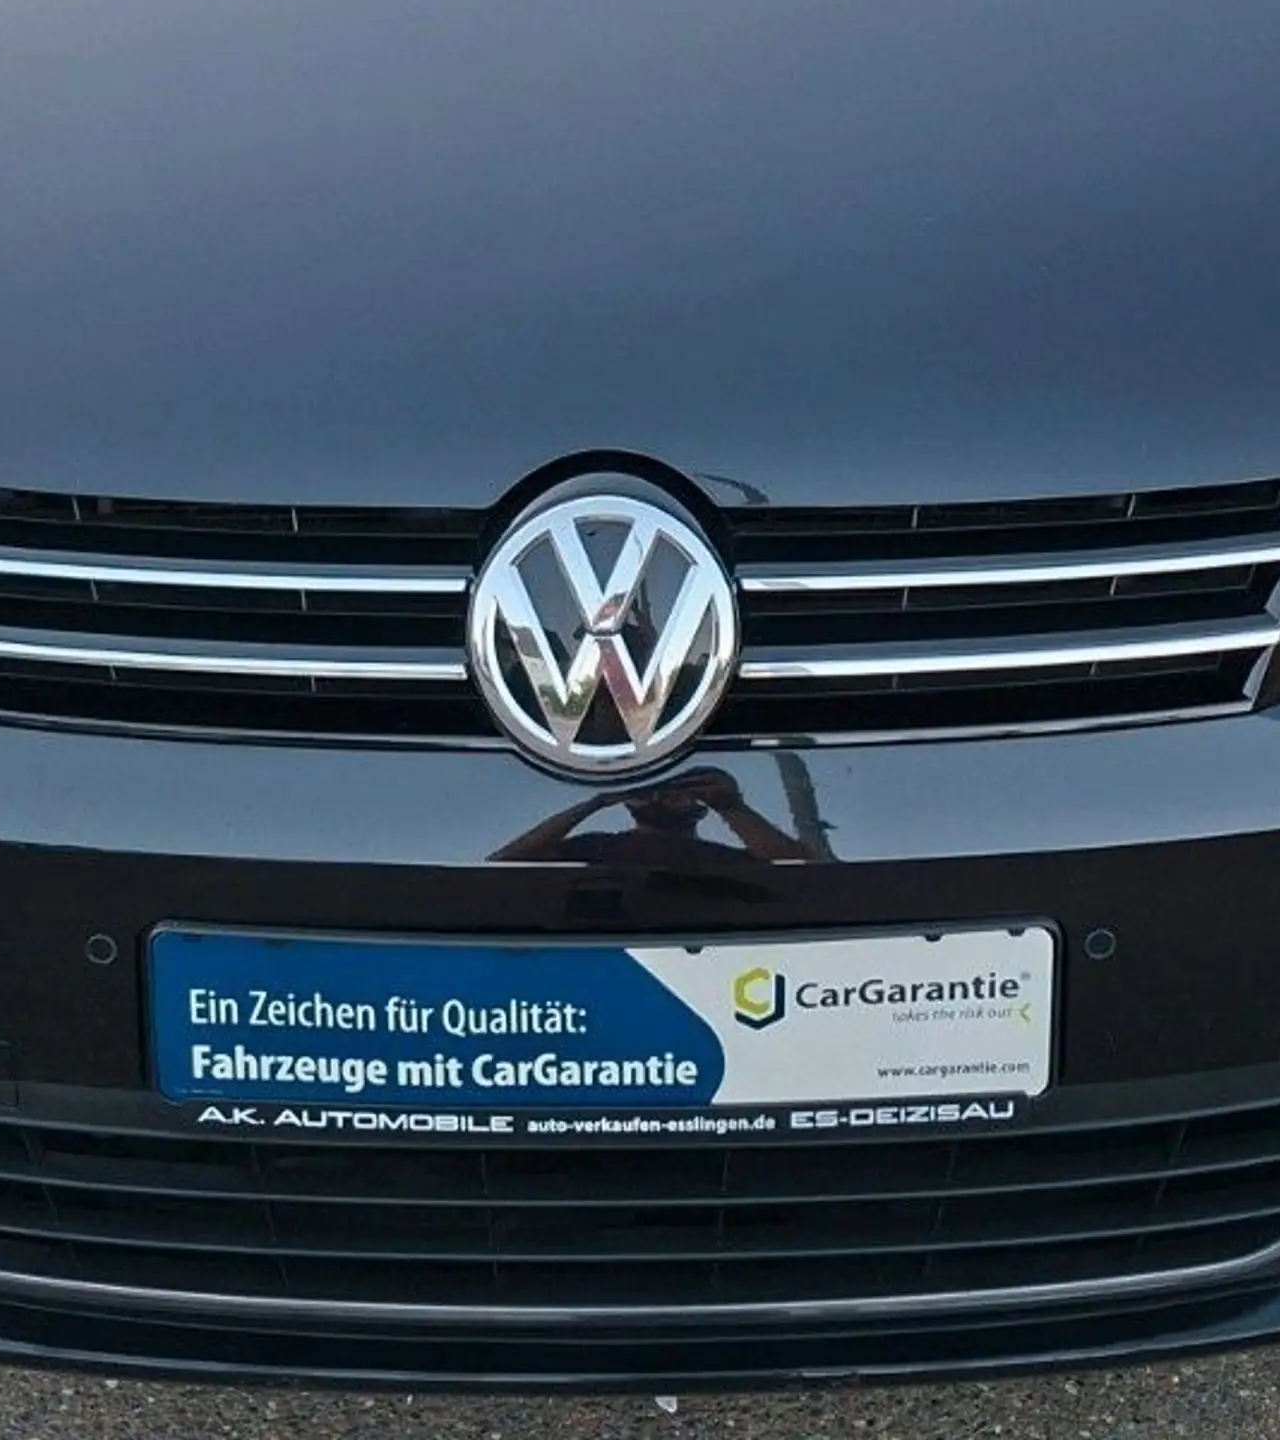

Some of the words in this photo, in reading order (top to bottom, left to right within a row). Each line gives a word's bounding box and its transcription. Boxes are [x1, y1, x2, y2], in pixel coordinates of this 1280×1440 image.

[795, 971, 1020, 1009] CarGarantie
[189, 988, 238, 1024] Ein
[248, 990, 376, 1031] Zeichen
[385, 996, 434, 1034] für
[442, 998, 587, 1037] Qualität:
[932, 1007, 957, 1021] the
[191, 1044, 388, 1093] Fahrzeuge
[397, 1053, 463, 1087] mit
[471, 1052, 698, 1087] CarGarantie
[876, 1060, 1031, 1079] www.cargarantie.com
[197, 1106, 265, 1125] A.K.
[273, 1108, 514, 1133] AUTOMOBILE
[527, 1113, 776, 1134] auto-verkaufen-esslingen.de
[790, 1099, 1015, 1129] ES-DEIZISAU
